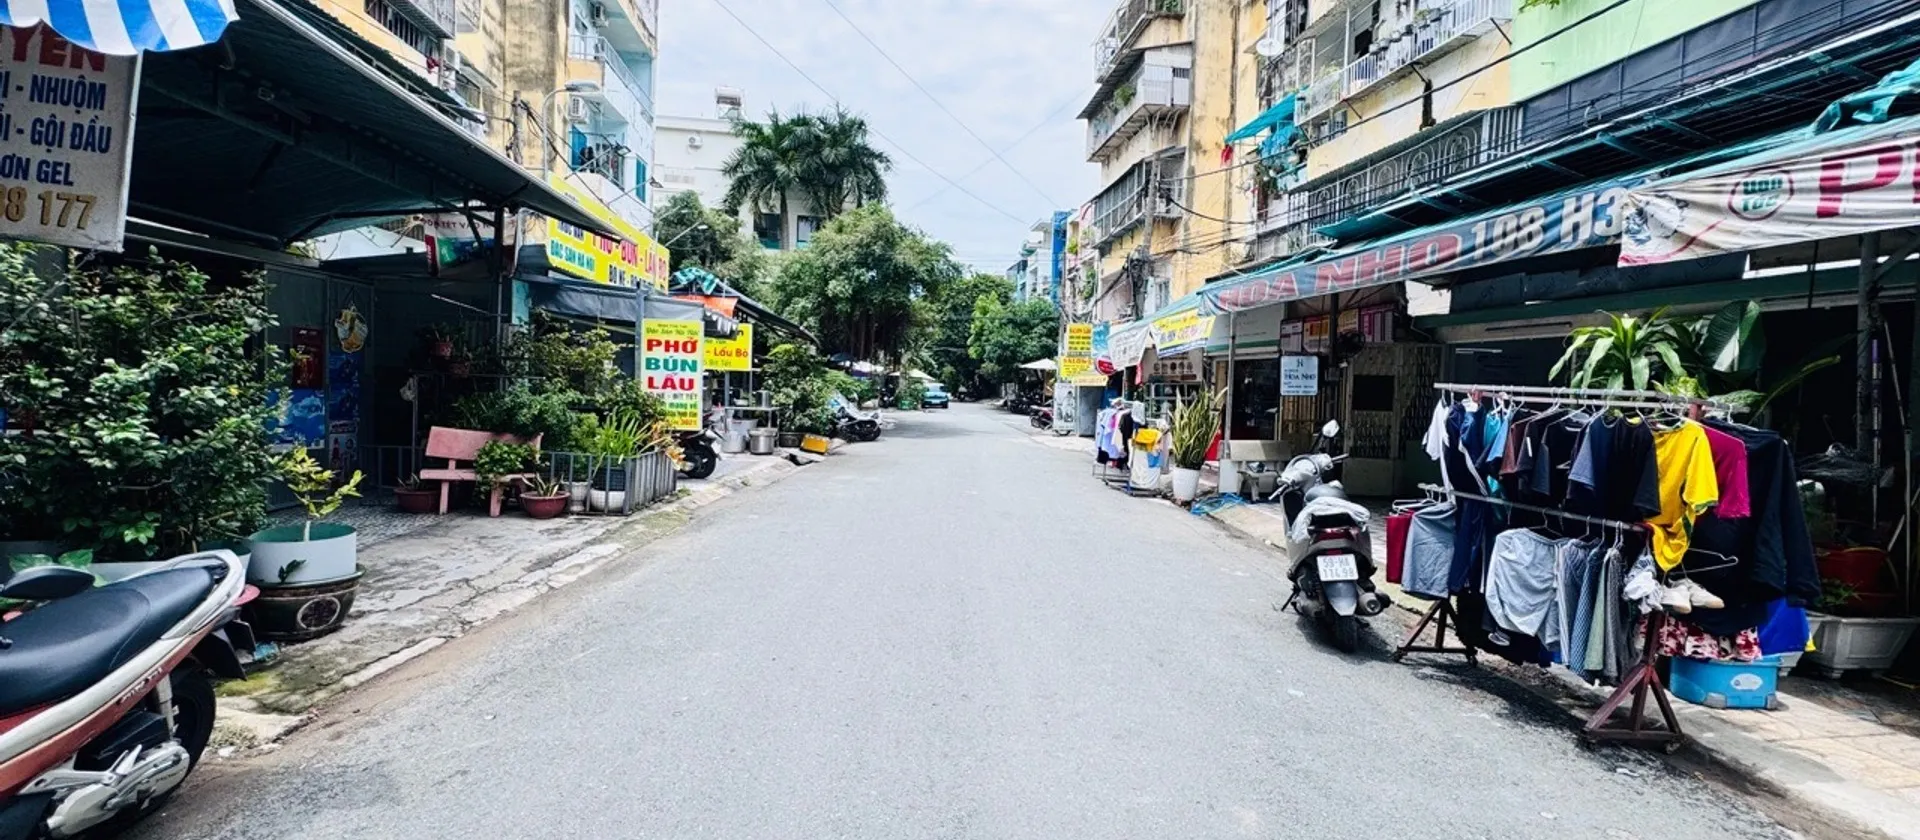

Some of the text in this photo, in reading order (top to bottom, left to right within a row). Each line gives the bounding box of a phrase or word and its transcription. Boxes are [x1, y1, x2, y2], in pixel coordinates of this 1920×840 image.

[29, 74, 107, 115] NHUỘM
[30, 113, 66, 153] GỘI
[69, 115, 113, 153] ĐẦU
[36, 159, 74, 186] GEL
[38, 190, 97, 231] 177
[1470, 206, 1545, 261] 108
[645, 355, 698, 373] BÚN
